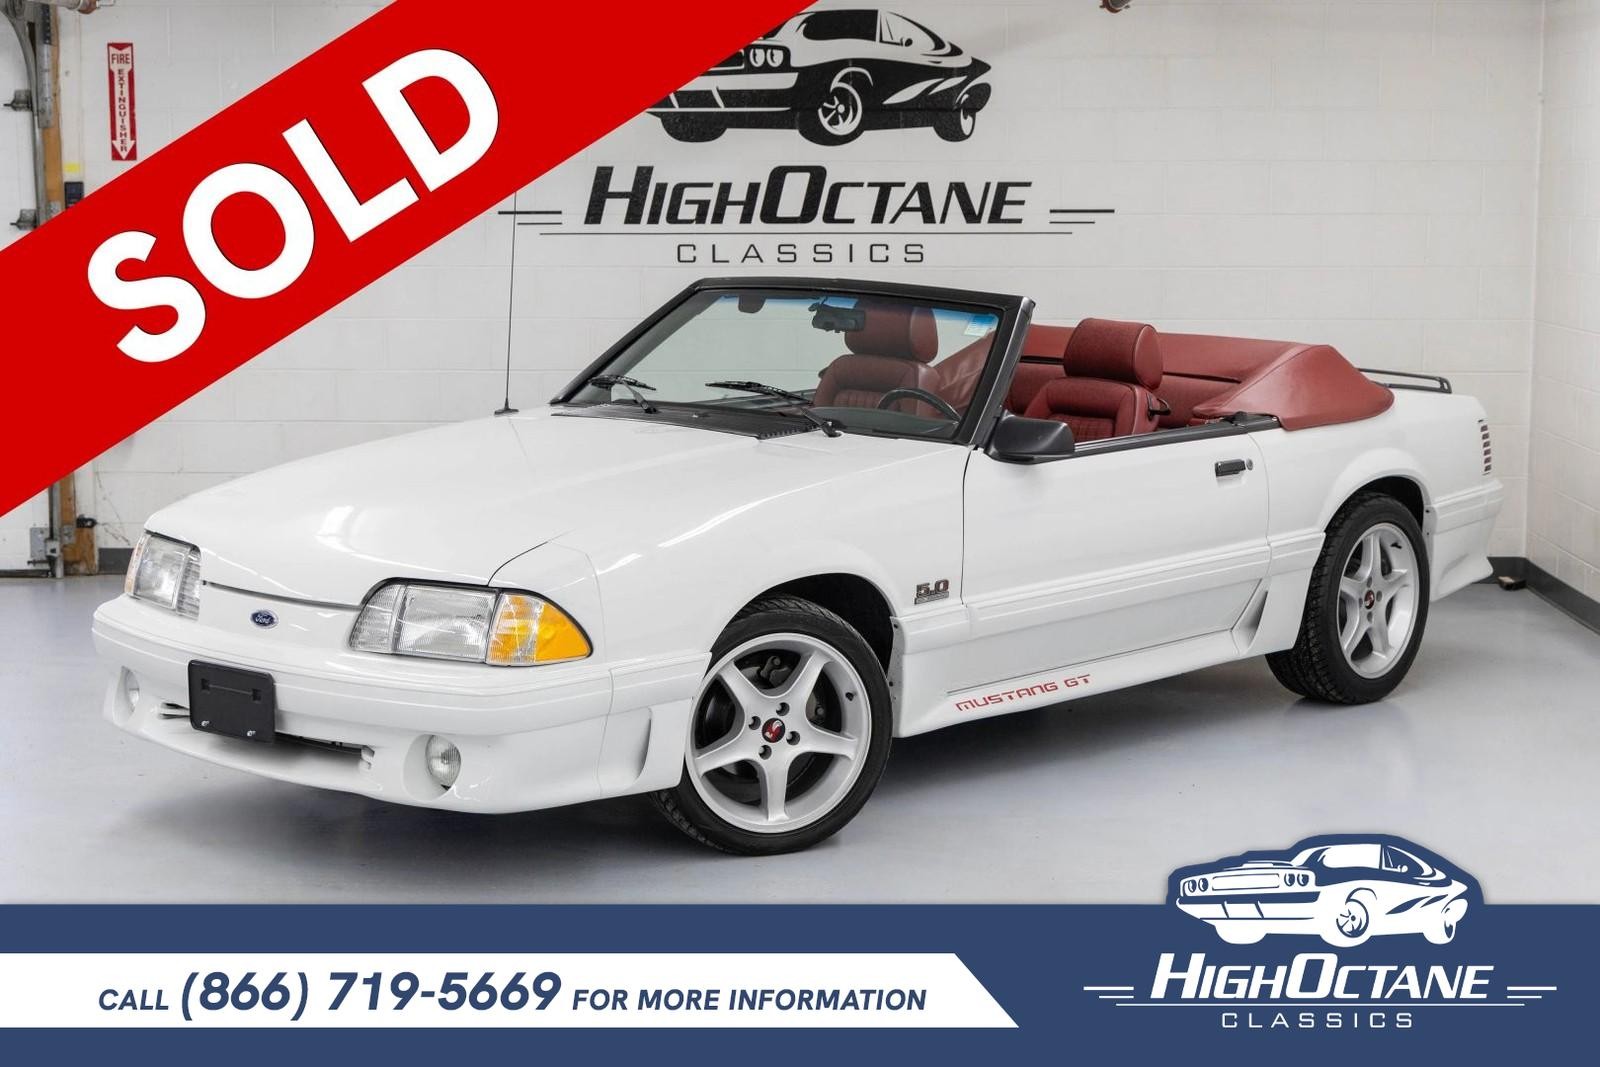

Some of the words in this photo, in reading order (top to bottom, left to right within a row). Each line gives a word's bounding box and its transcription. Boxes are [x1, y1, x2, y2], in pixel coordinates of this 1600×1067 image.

[111, 53, 130, 64] FIRE
[118, 69, 128, 152] EXTINGUISHER
[676, 243, 924, 264] CLASSICS
[916, 579, 949, 598] 5.0
[955, 681, 1059, 711] MUSTANG
[1063, 673, 1091, 688] GT
